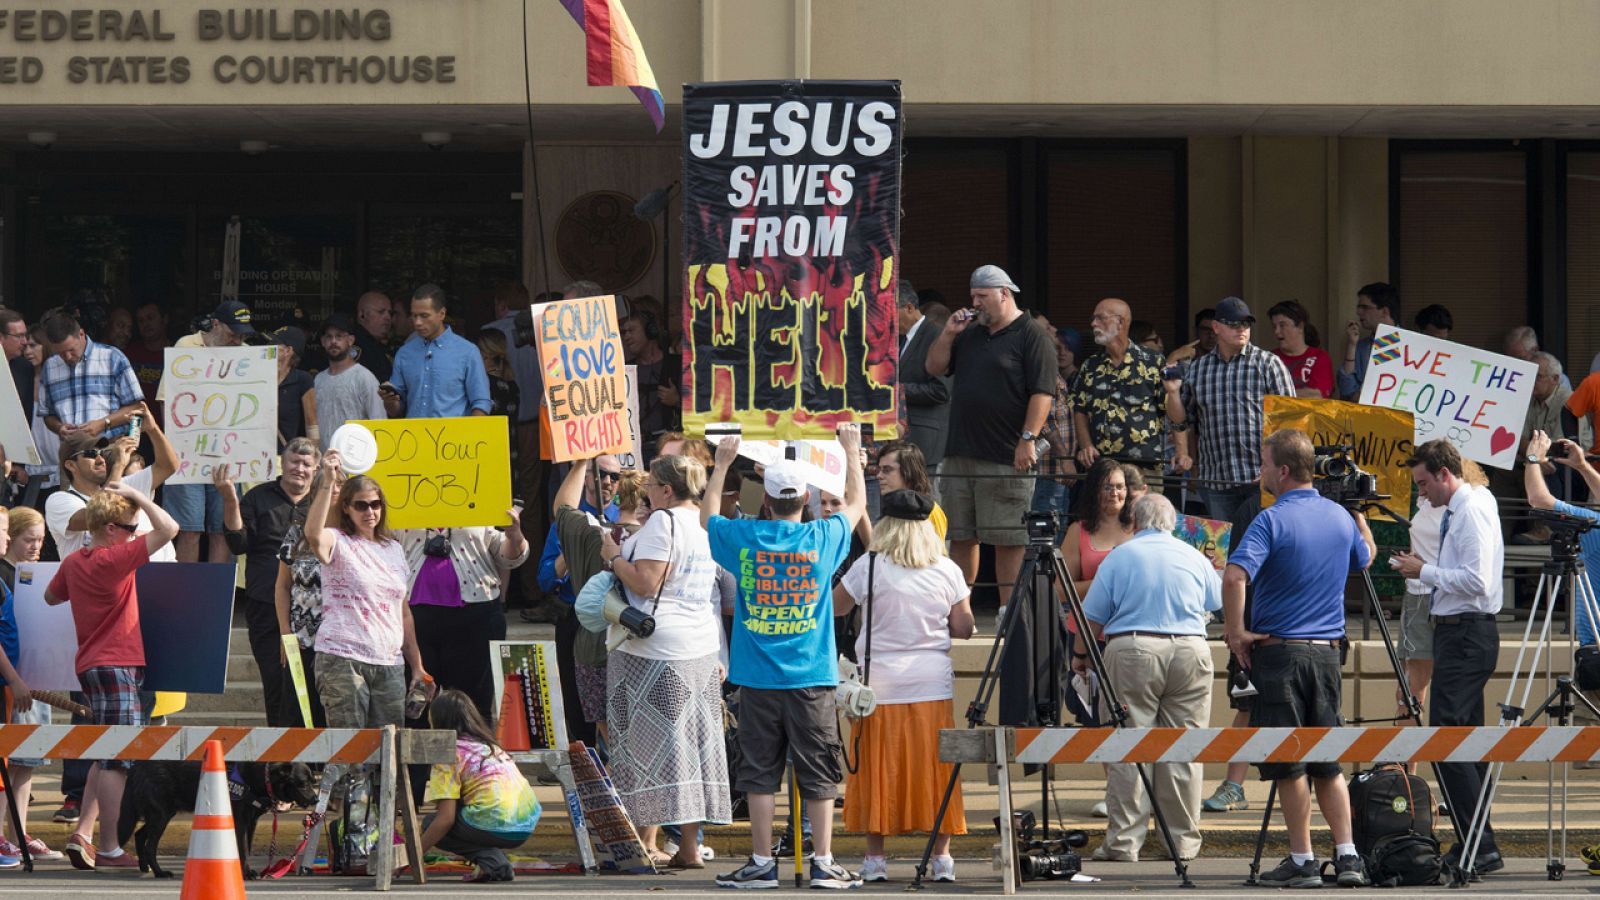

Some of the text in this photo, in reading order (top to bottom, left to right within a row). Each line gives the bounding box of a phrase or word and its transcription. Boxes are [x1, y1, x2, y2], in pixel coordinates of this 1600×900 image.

[198, 8, 391, 41] BUILDING
[67, 55, 191, 84] STATES
[213, 54, 456, 84] COURTHOUSE
[689, 100, 896, 159] JESUS
[727, 164, 856, 208] SAVES
[728, 215, 848, 259] FROM
[213, 270, 339, 281] BDING OPERATION
[255, 283, 297, 293] HOURS
[254, 299, 297, 311] Monday
[542, 299, 618, 343] EQUAL
[690, 291, 894, 414] HELL
[1403, 344, 1523, 392] WE THE
[171, 391, 260, 428] GOD
[549, 376, 624, 422] EQUAL
[1372, 373, 1498, 430] PEOPLE
[374, 426, 488, 463] DO Your
[565, 411, 623, 455] RIGHTS
[1352, 431, 1412, 468] WINS
[386, 464, 480, 510] JOB!
[740, 576, 819, 591] BIBLICAL
[786, 565, 811, 577] OF
